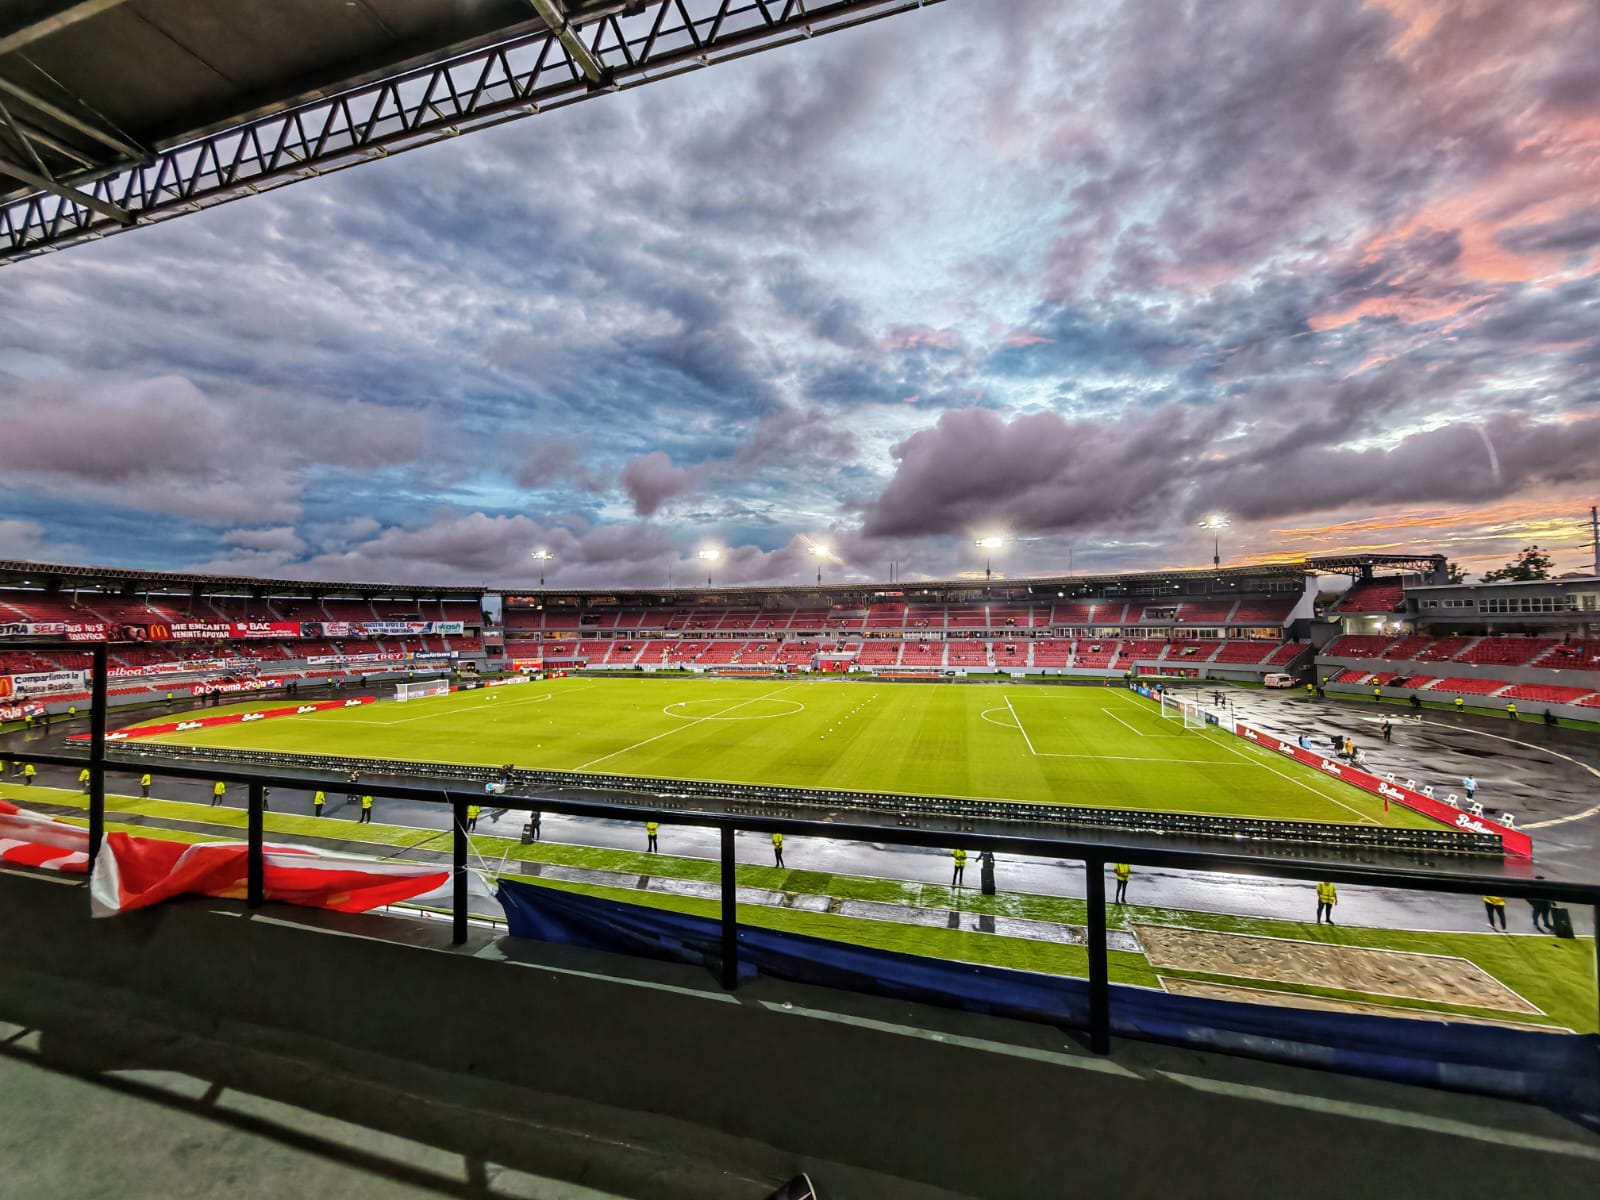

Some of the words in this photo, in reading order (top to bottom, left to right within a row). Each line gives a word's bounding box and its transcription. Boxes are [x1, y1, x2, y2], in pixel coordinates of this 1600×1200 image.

[171, 623, 187, 631] ME
[188, 623, 230, 631] ENCANTA
[249, 622, 271, 631] BAC
[107, 667, 143, 677] alboa
[14, 673, 70, 684] Compartimos
[71, 672, 79, 680] la
